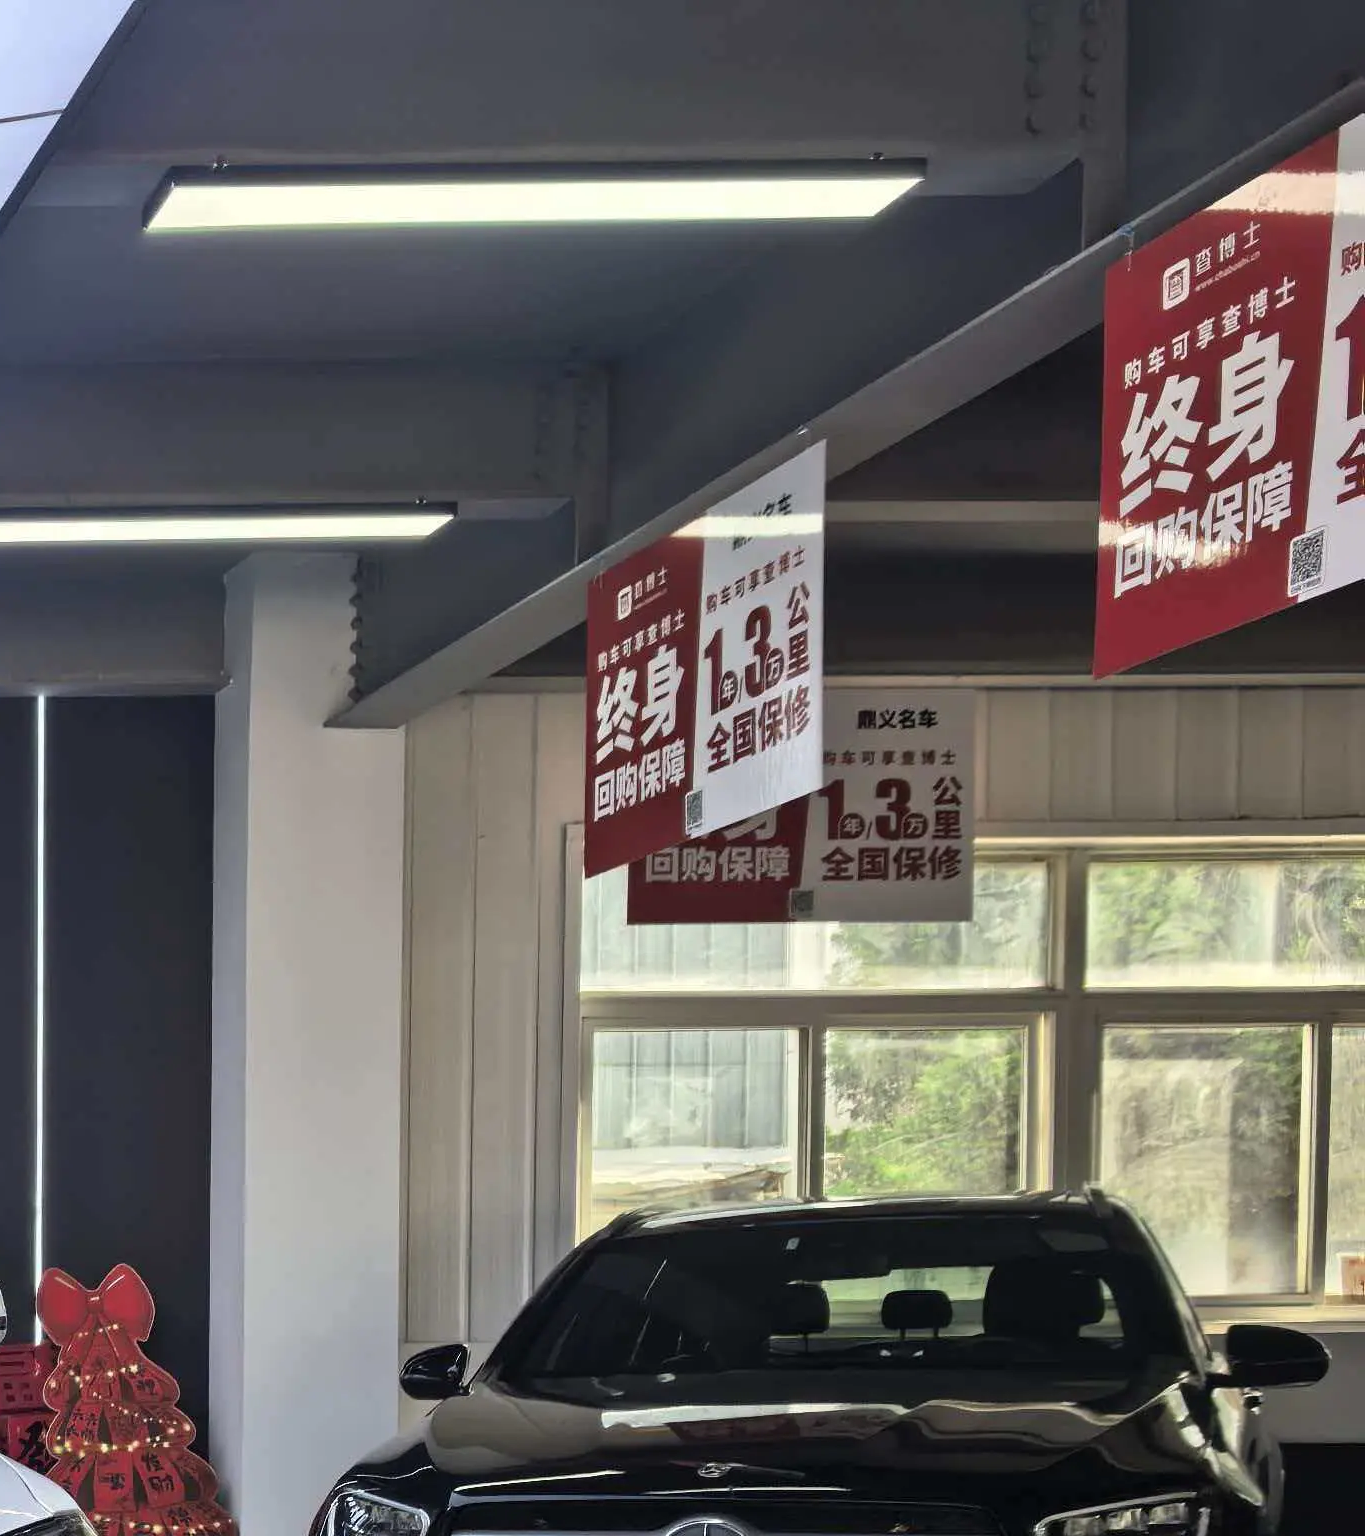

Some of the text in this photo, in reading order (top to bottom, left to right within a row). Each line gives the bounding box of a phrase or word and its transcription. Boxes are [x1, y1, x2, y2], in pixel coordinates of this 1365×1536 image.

[1124, 276, 1296, 390] 购车可享查博士
[1119, 330, 1295, 519] 终身
[1114, 460, 1294, 600] 回购保障
[595, 644, 685, 765] 终身
[707, 684, 811, 774] 全国保修
[857, 708, 939, 731] 鼎义名车
[594, 738, 686, 822] 回购保障
[645, 845, 791, 884] 回购保障
[821, 847, 963, 882] 全国保修
